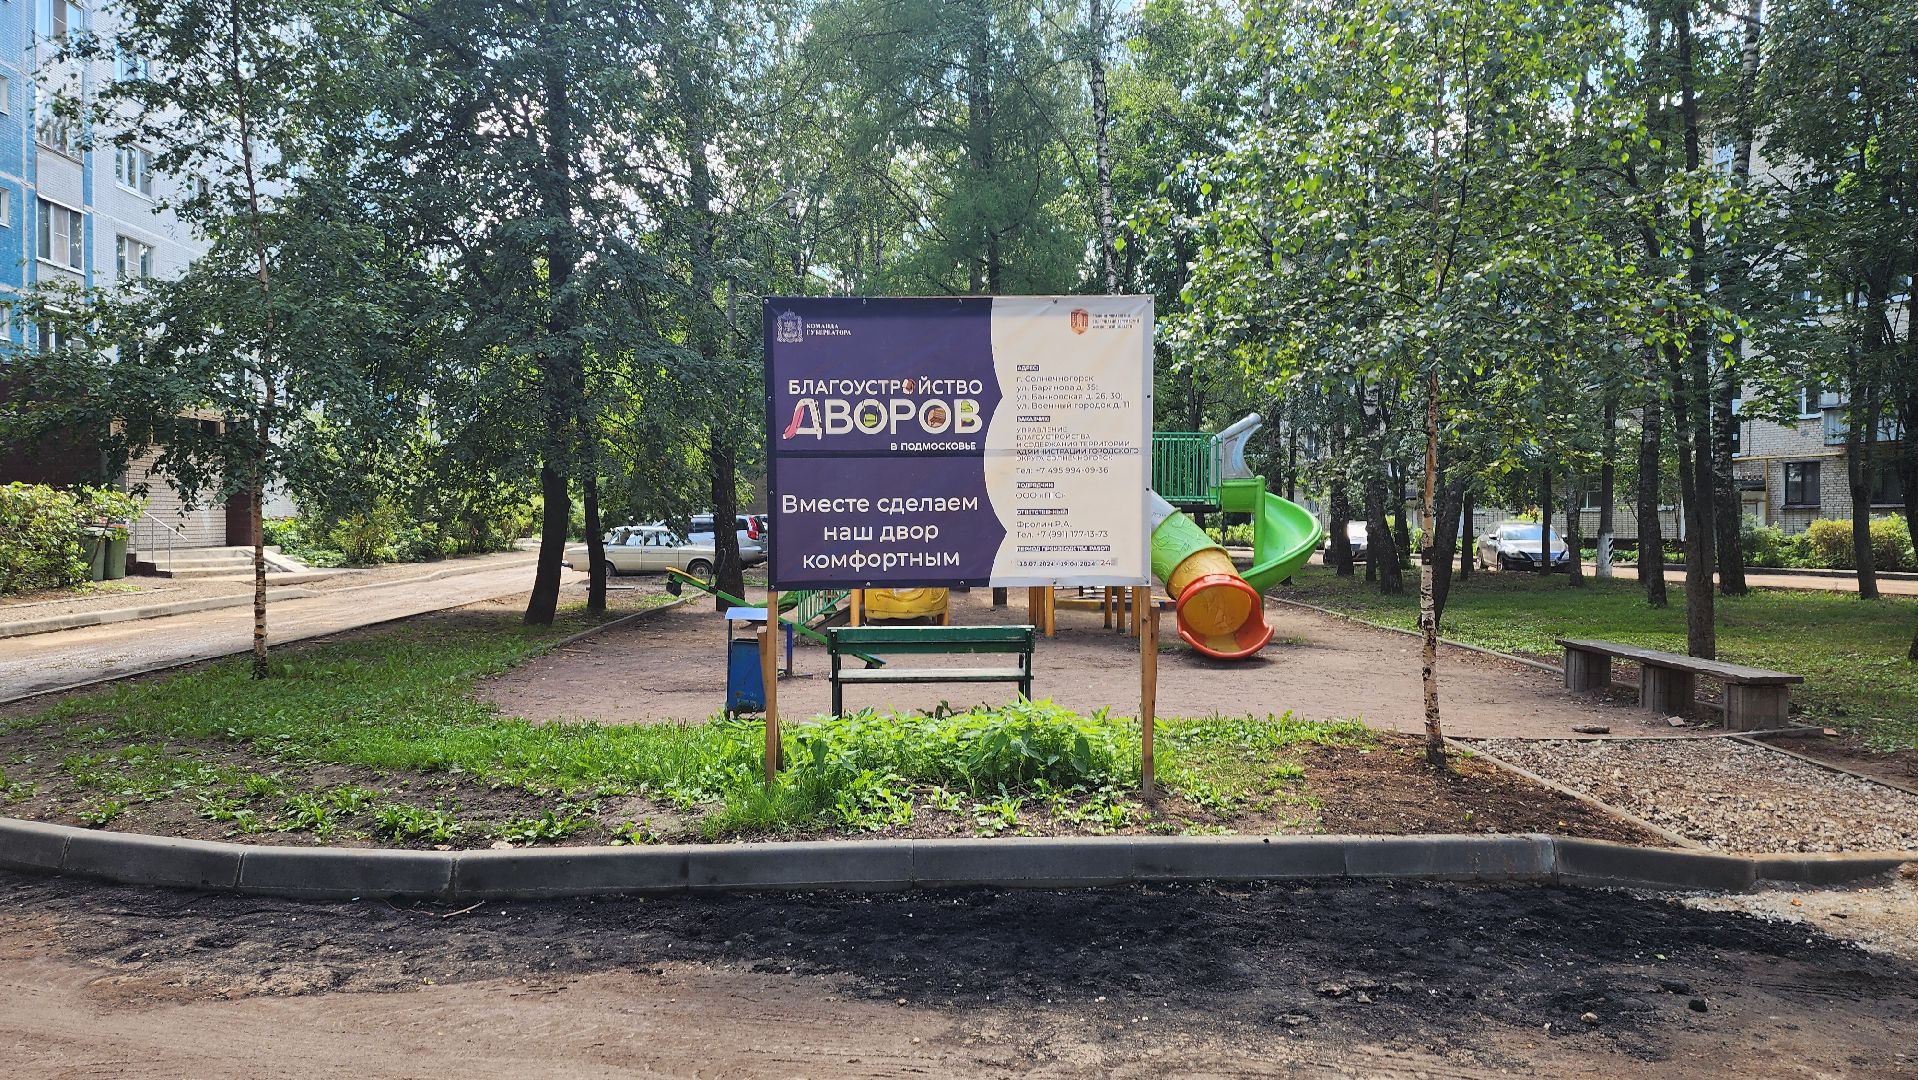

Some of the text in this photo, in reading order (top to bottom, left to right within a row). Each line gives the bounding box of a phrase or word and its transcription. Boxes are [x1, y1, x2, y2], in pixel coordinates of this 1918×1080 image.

[1025, 375, 1094, 383] Солнечногорск
[1031, 401, 1072, 410] Военный
[1074, 402, 1112, 410] городок
[783, 398, 983, 440] ДВОРОВ
[1016, 433, 1091, 441] БЛАГОУСТРОЙСТВА
[901, 442, 977, 451] ПОДМОСКОВЬЕ
[782, 494, 978, 515] Вместе сделаем
[1016, 521, 1053, 529] Фролин
[824, 524, 939, 543] наш двор
[803, 550, 960, 573] комфортным
